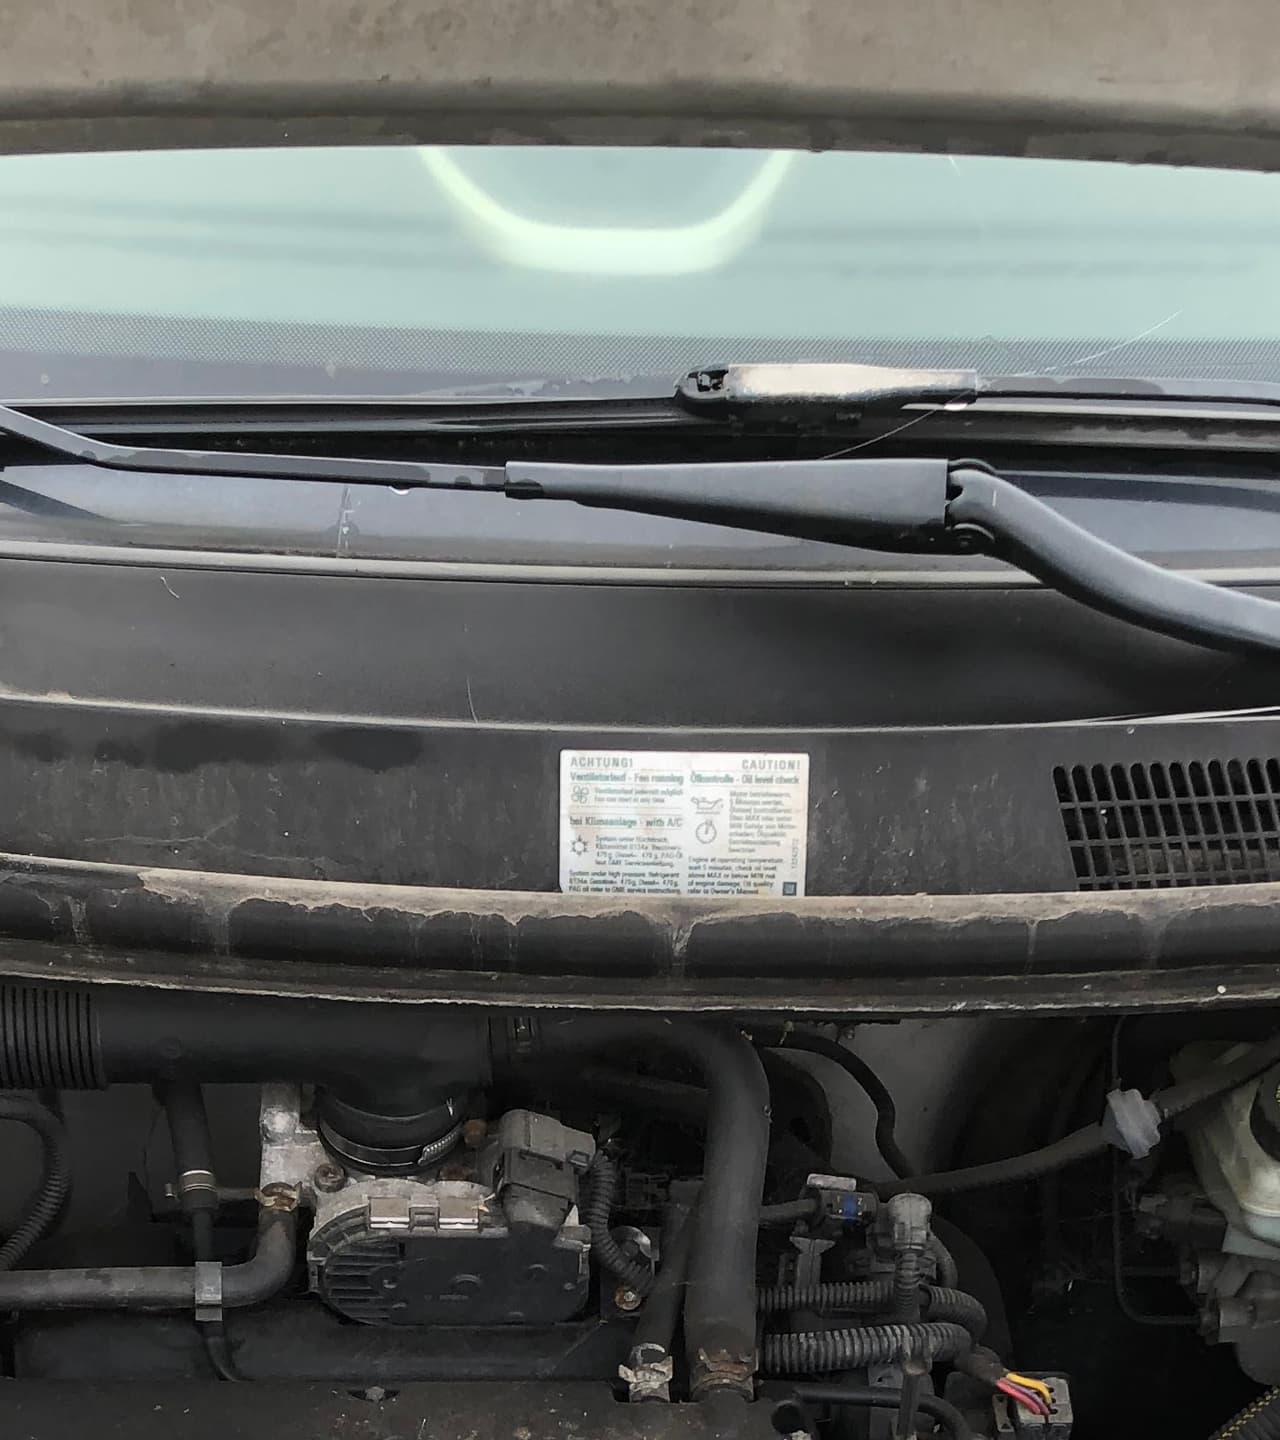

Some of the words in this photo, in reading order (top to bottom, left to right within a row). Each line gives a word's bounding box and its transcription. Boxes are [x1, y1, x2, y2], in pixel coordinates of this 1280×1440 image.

[570, 757, 633, 768] ACHTUNG!
[742, 759, 801, 770] CAUTION!
[755, 775, 773, 784] level
[775, 775, 799, 784] check
[646, 818, 665, 827] with
[667, 818, 682, 827] A/C
